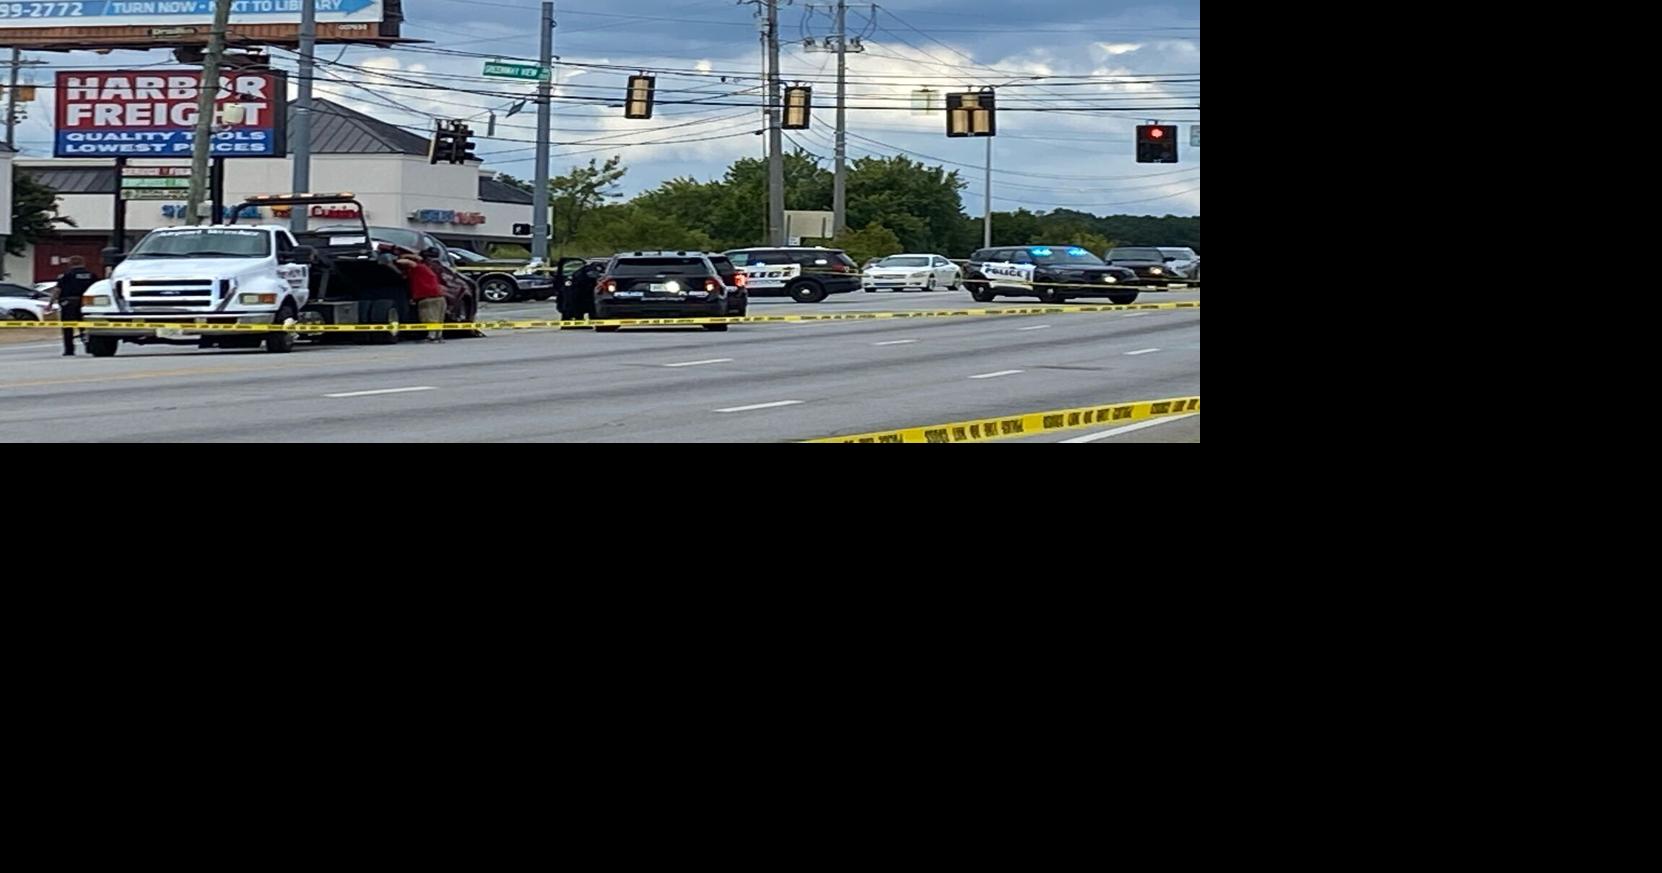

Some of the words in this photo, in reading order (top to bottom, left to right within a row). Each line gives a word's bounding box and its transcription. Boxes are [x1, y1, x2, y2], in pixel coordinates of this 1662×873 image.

[112, 2, 155, 13] TURN
[158, 1, 197, 13] NOW
[208, 0, 249, 12] NXT
[254, 0, 273, 11] TO
[277, 0, 340, 11] LIBARY
[67, 132, 175, 141] QUALITY
[181, 132, 266, 141] TOLS
[66, 144, 167, 152] LOWEST
[174, 143, 265, 152] PICES
[985, 267, 1022, 277] POLICE
